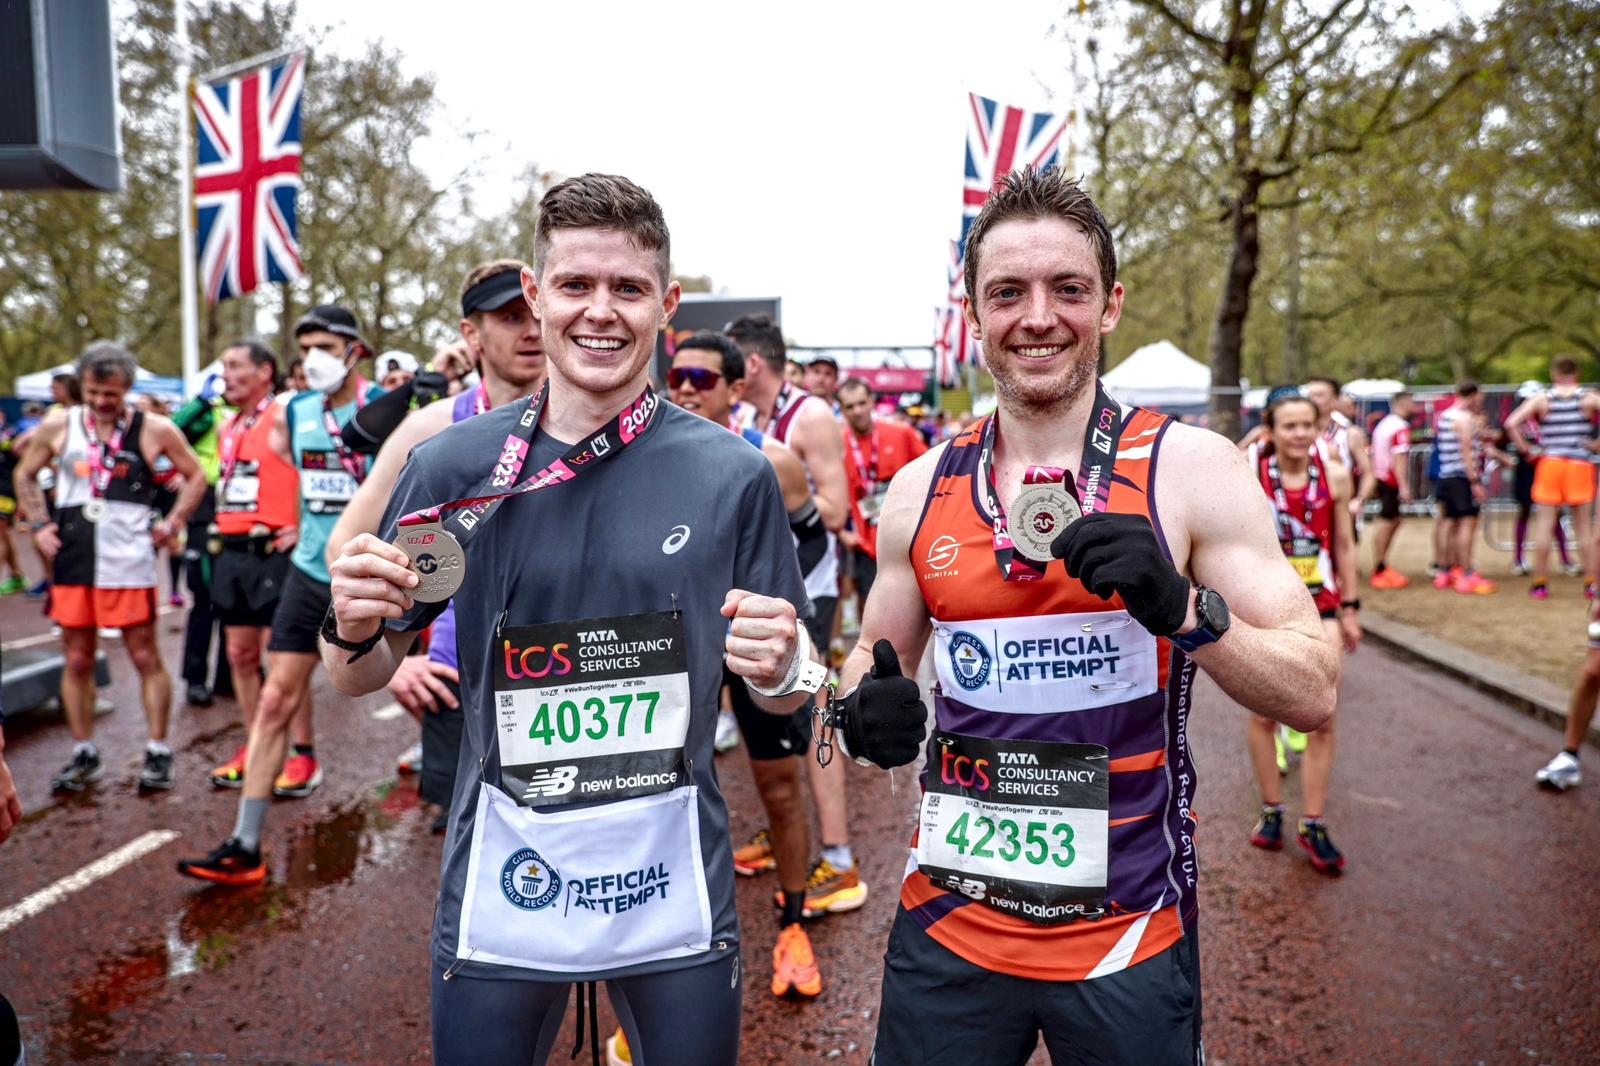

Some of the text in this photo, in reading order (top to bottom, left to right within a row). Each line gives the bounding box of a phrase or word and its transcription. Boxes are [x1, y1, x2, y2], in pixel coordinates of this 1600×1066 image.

[623, 393, 654, 434] 2023
[1098, 407, 1116, 430] tcs
[492, 441, 521, 487] 2023
[1083, 465, 1101, 512] FINISHER
[924, 570, 958, 580] SCIMITAR
[577, 629, 618, 643] TATA
[578, 638, 673, 658] CONSULTANCY
[1004, 635, 1120, 660] OFFICIAL
[504, 639, 574, 680] tcs
[580, 656, 640, 673] SERVICES
[966, 657, 990, 687] RECORDS
[1006, 655, 1120, 681] ATTEMPT
[564, 683, 617, 693] #WeRunTogether
[529, 691, 660, 746] 40377
[941, 744, 990, 791] tcs
[997, 752, 1039, 765] TATA
[581, 780, 613, 794] new
[616, 772, 677, 790] balance
[997, 767, 1095, 784] CONSULTANCY
[997, 781, 1059, 797] SERVICES
[946, 811, 1076, 868] 42353
[504, 871, 559, 908] WORLD RECORDS
[568, 863, 669, 896] OFFICIAL
[574, 881, 669, 914] ATTEMPT
[991, 896, 1019, 910] new
[1023, 901, 1085, 919] balance
